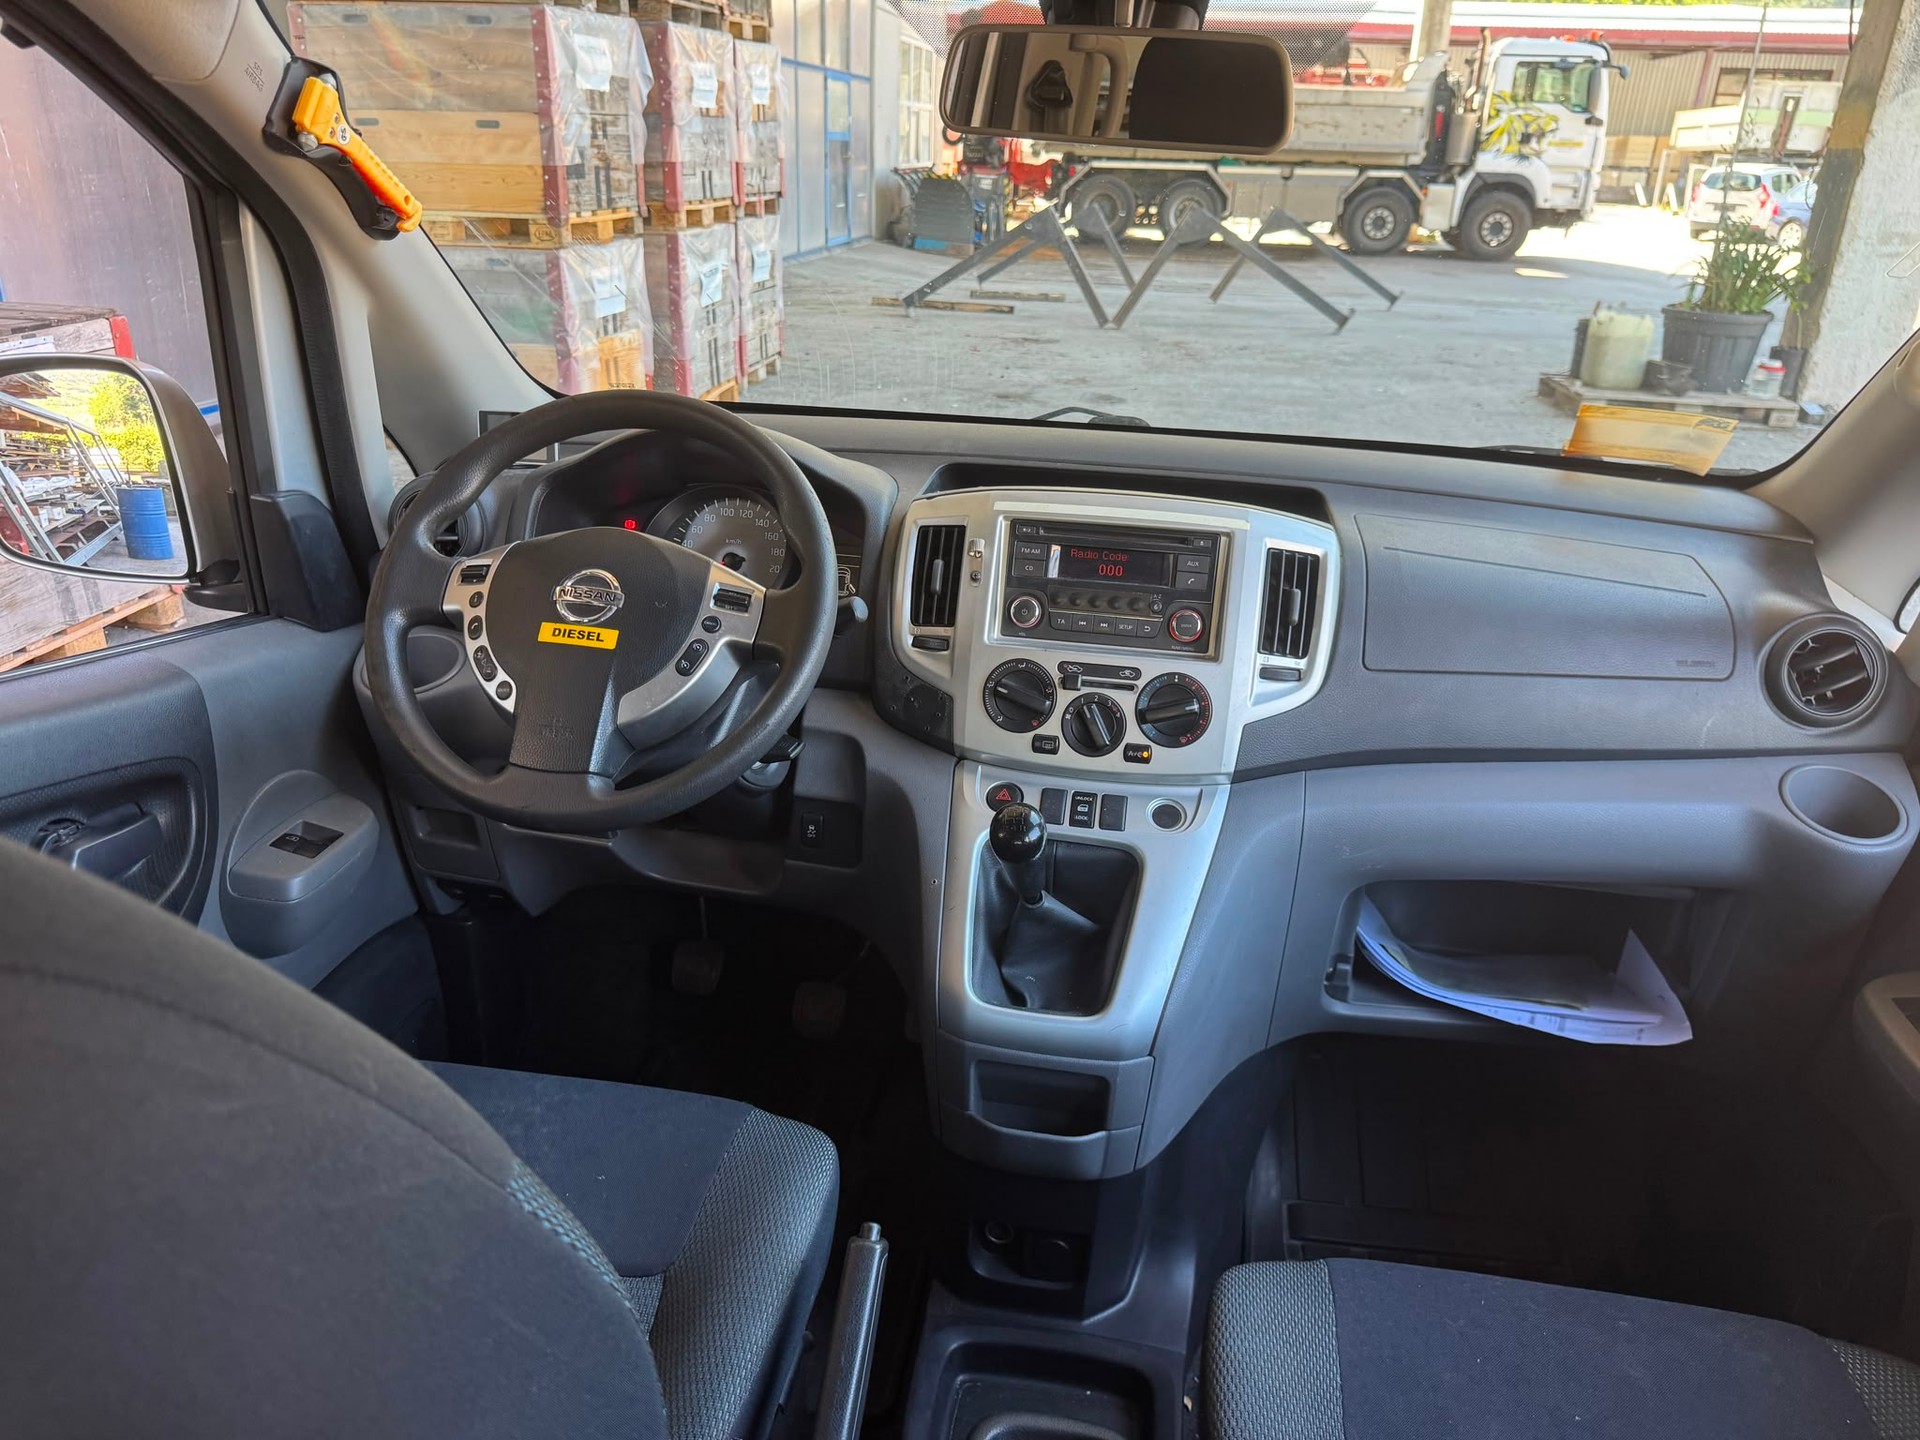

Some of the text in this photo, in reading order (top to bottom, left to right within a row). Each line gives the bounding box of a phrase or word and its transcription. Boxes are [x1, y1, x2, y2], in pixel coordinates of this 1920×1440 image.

[720, 507, 734, 517] 100
[740, 509, 753, 518] 120
[704, 513, 716, 522] 80
[755, 518, 770, 528] 140
[691, 525, 703, 534] 60
[764, 531, 779, 541] 160
[681, 539, 693, 548] 40
[770, 547, 785, 556] 180
[1070, 548, 1128, 562] Radio Code
[769, 564, 782, 574] 20
[1098, 563, 1124, 577] 000
[559, 587, 617, 602] NISSAN
[551, 627, 605, 643] DIESEL
